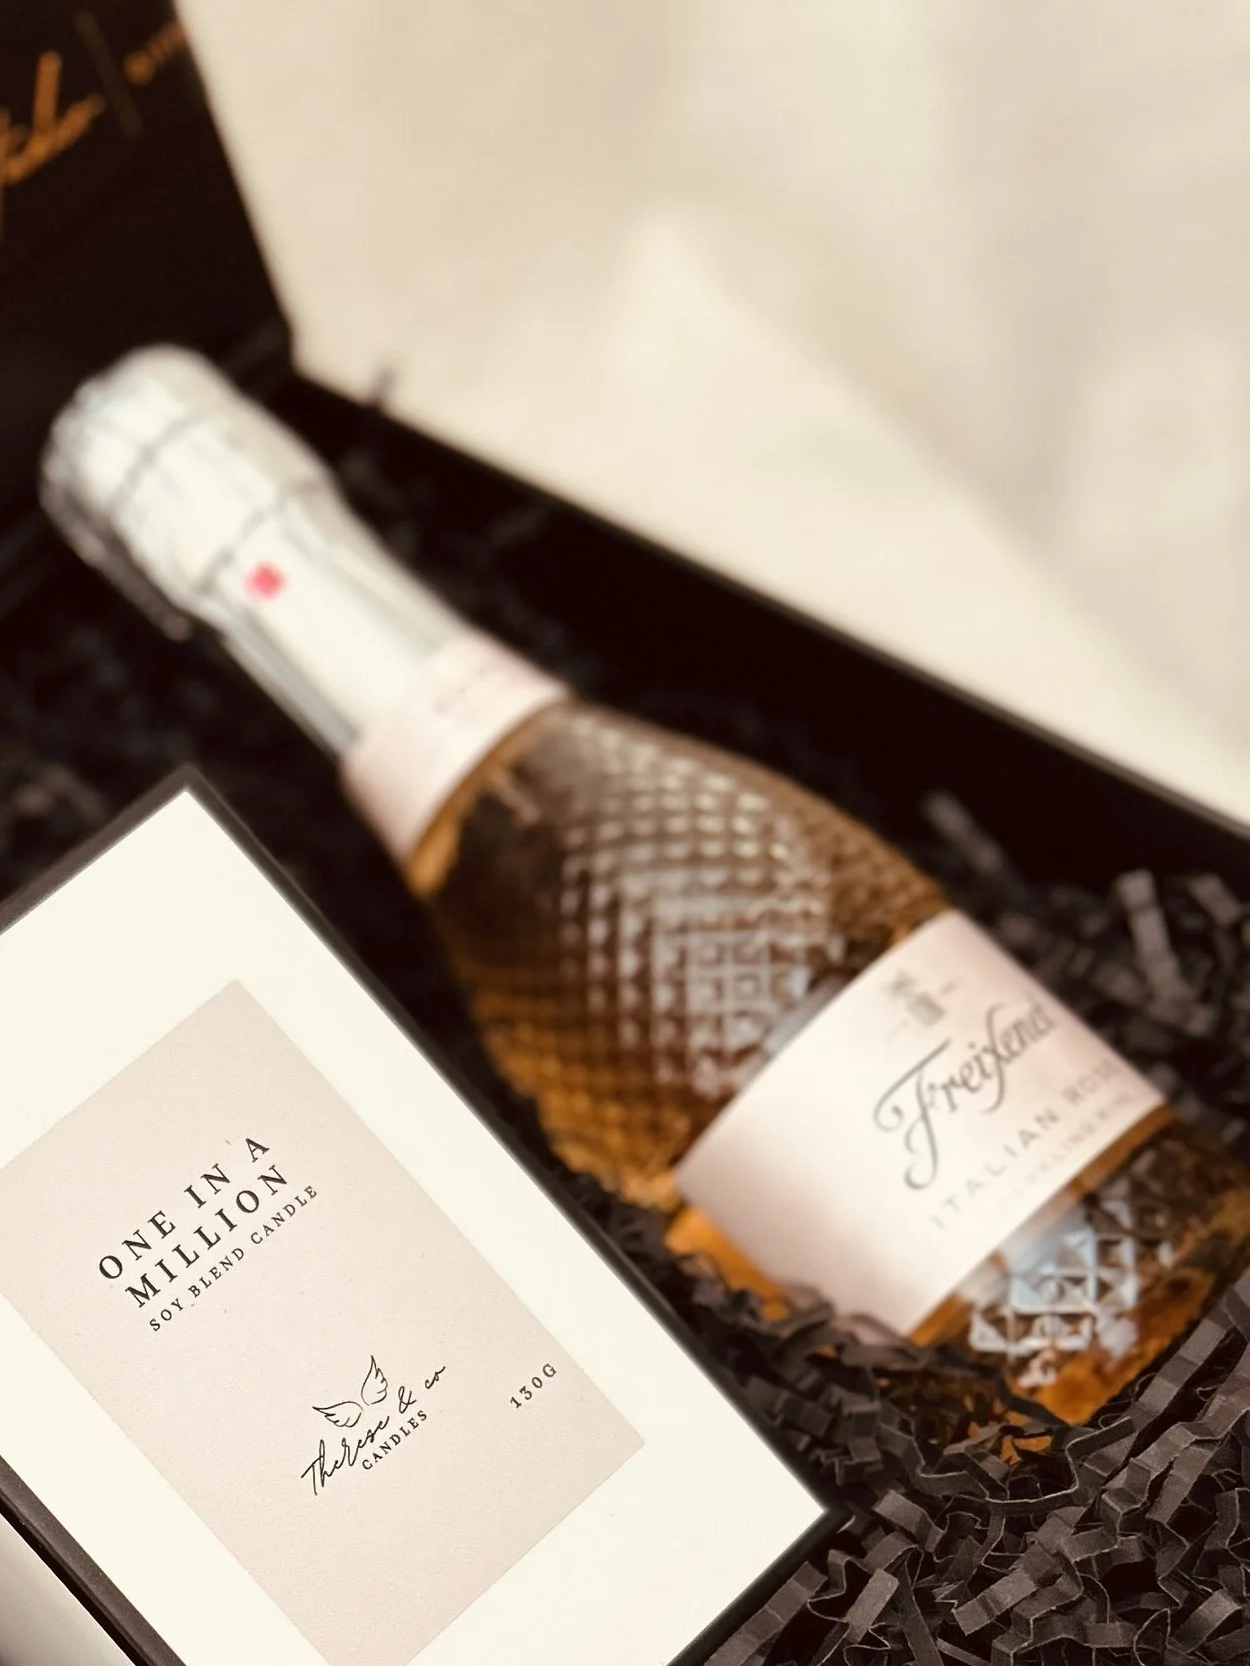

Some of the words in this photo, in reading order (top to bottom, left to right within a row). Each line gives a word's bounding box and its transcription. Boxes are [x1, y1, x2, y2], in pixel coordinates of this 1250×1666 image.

[98, 1209, 176, 1280] ONE
[183, 1162, 231, 1209] IN
[245, 1137, 270, 1163] A
[929, 1104, 1061, 1230] ITALIAN
[124, 1164, 288, 1309] MILLION
[149, 1297, 184, 1332] SOY
[188, 1247, 245, 1299] BLEND
[250, 1185, 318, 1245] CANDLE
[300, 1415, 390, 1496] Therese
[397, 1385, 417, 1414] &
[361, 1409, 428, 1471] CANDLES
[508, 1362, 558, 1410] 130G
